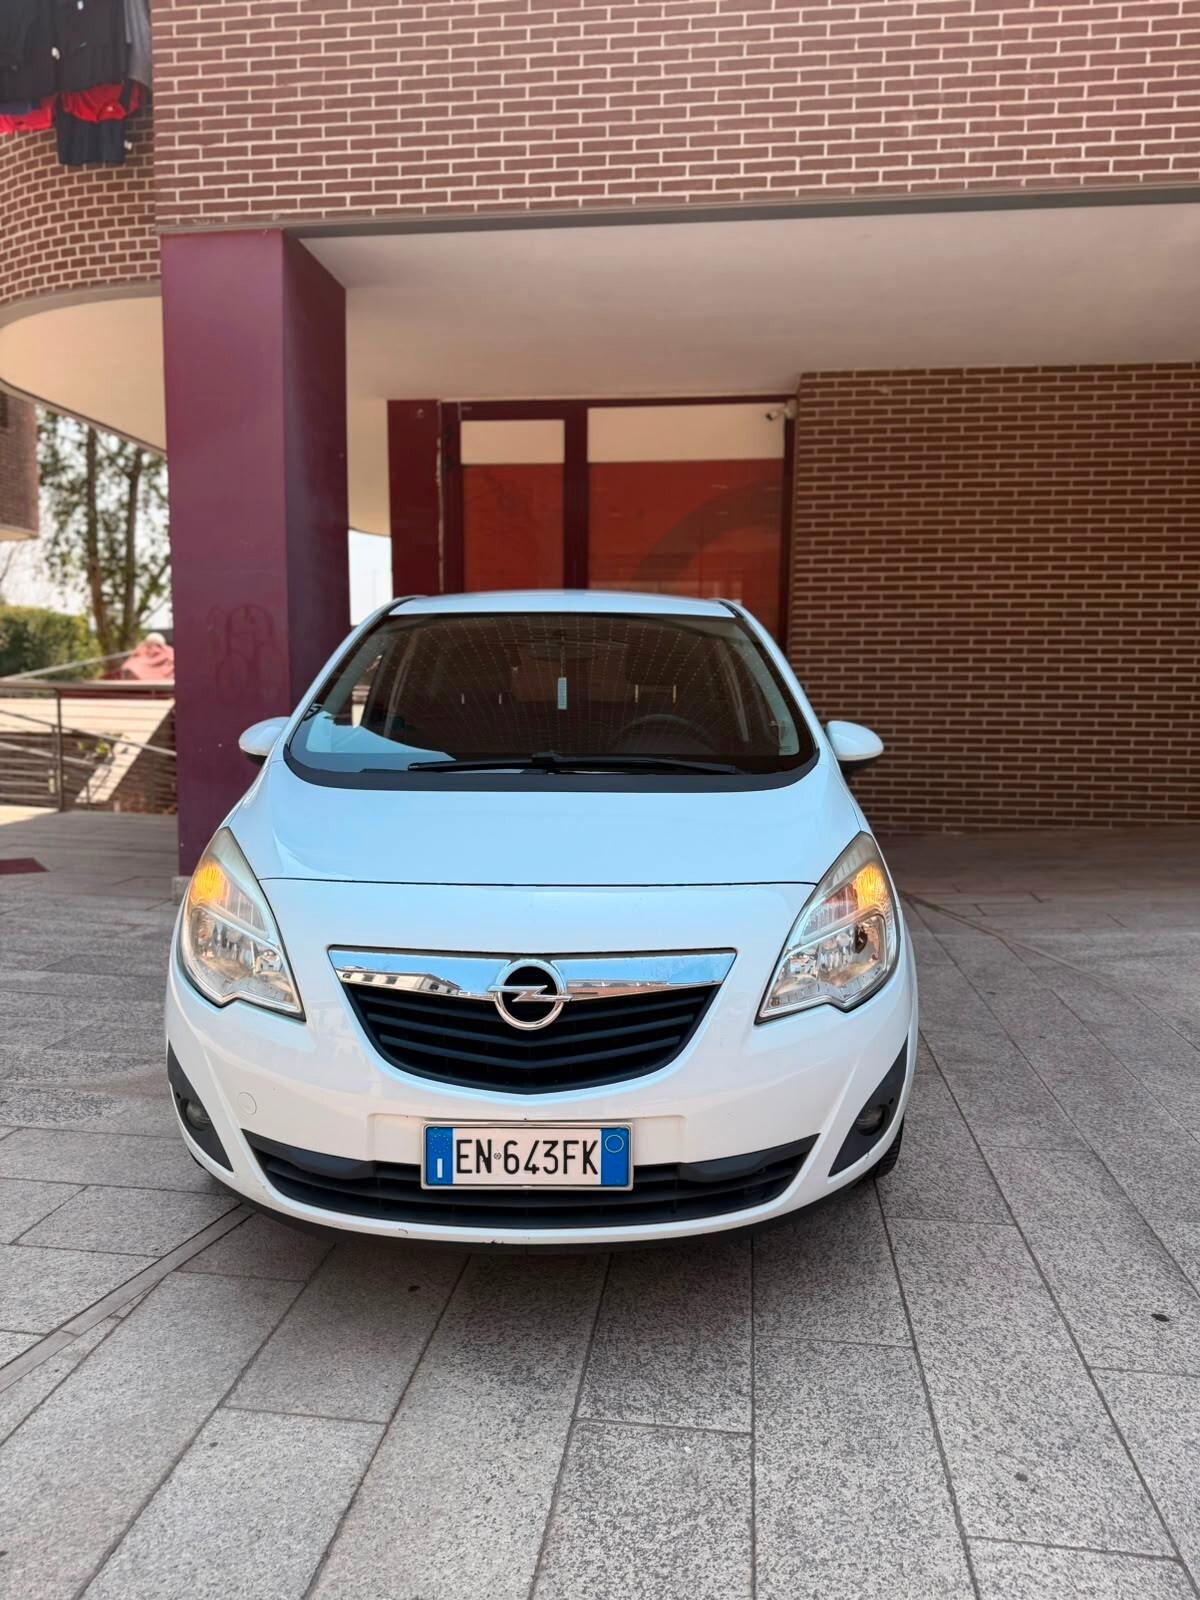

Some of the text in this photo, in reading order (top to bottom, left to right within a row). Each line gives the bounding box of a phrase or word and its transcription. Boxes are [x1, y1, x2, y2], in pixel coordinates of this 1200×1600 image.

[436, 1157, 444, 1179] I
[456, 1139, 599, 1175] EN 643FK
